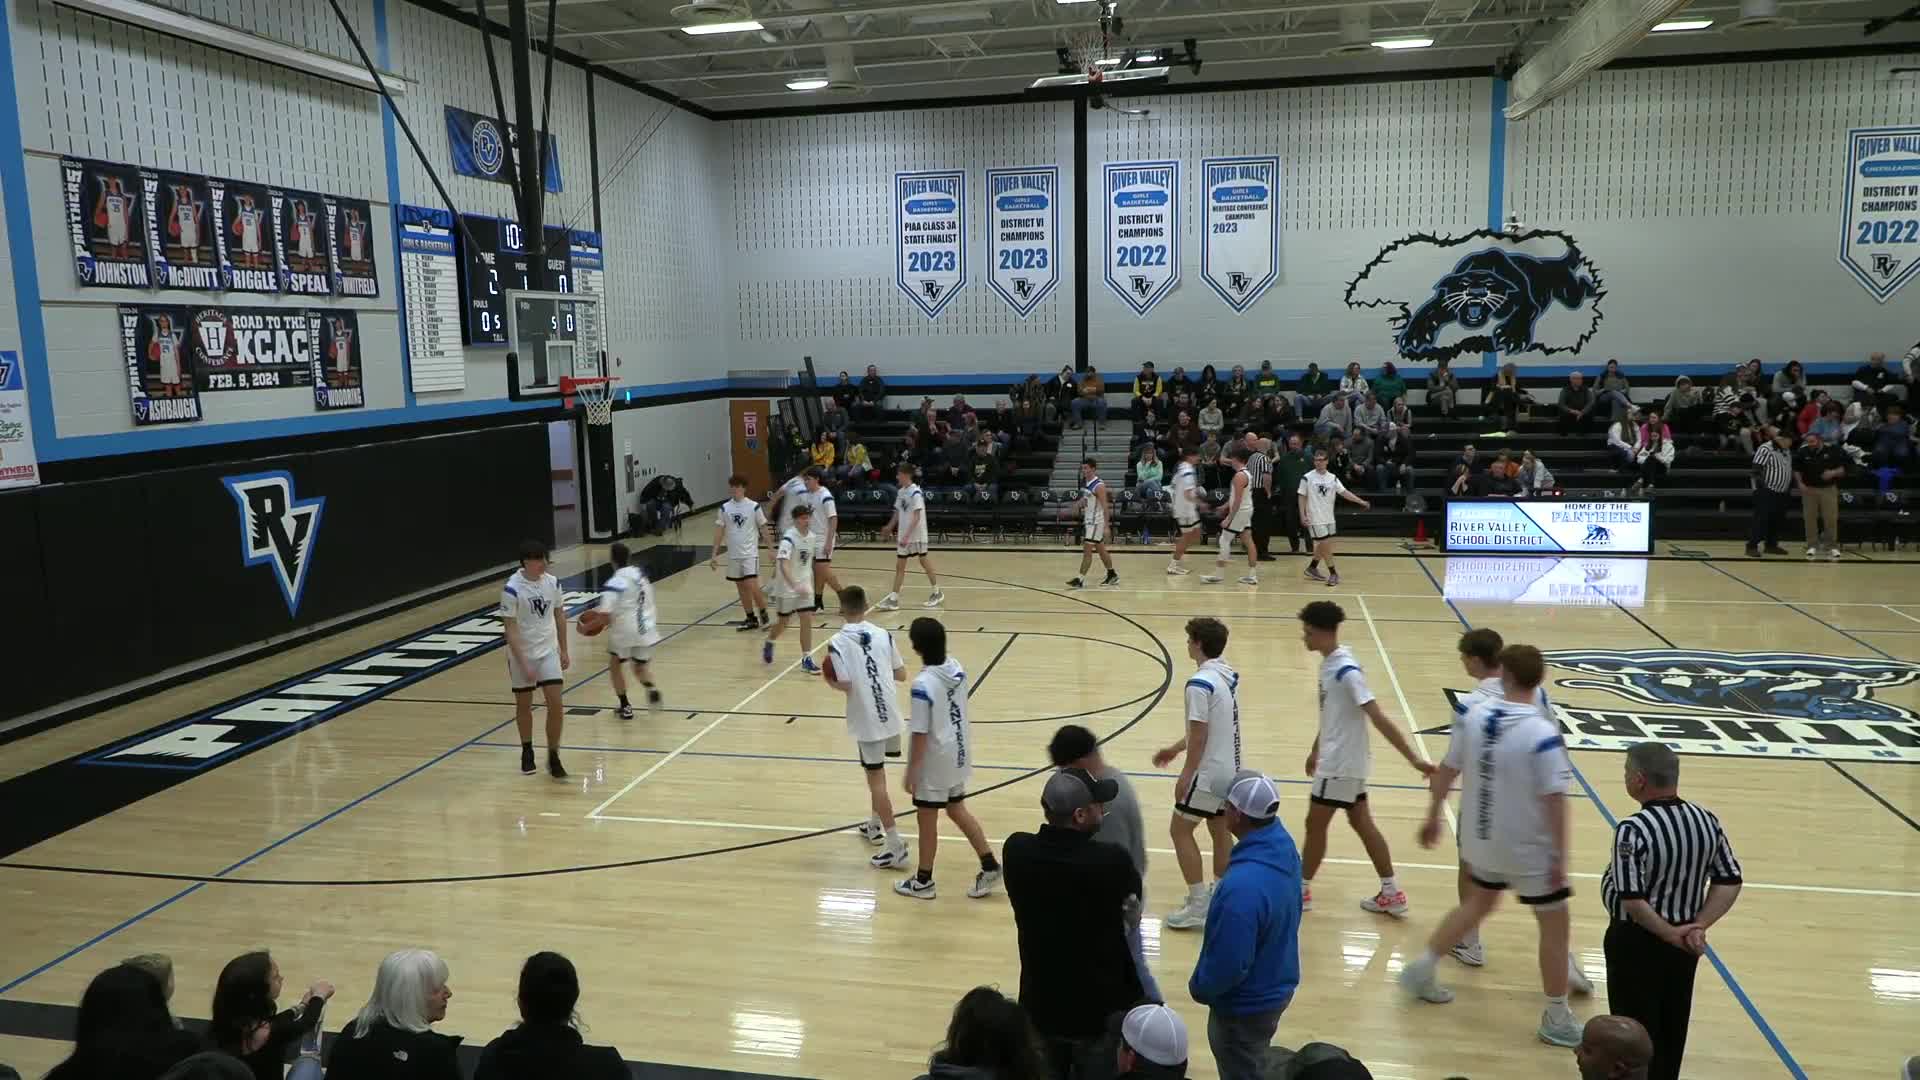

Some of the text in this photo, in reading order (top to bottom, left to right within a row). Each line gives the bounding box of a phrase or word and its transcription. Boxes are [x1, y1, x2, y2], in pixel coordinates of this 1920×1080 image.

[1858, 138, 1890, 160] RIVER
[994, 175, 1050, 196] RIVER VALLEY
[1112, 170, 1170, 192] RIVER VALLEY
[1210, 165, 1270, 187] RIVER VALLEY
[903, 179, 958, 200] RIVER VALLEY
[1863, 185, 1918, 197] DISTRICT VI
[66, 168, 92, 258] PANTHERS
[1212, 203, 1268, 212] HERITAGE CONFERENCE
[1225, 213, 1255, 221] CHAMPIONS
[1861, 200, 1918, 213] CHAMPIONS
[143, 179, 166, 262] PANTHERS
[211, 187, 232, 267] PANTHERS
[904, 221, 957, 232] PIAA CLASS 3A
[1001, 217, 1044, 229] DISTRICT VI
[1119, 214, 1163, 225] DISTRICT VI
[1213, 223, 1238, 233] 2023
[271, 196, 289, 271] PANTHERS
[325, 204, 343, 274] PANTHERS
[904, 234, 957, 245] STATE FINALIST
[1000, 231, 1045, 241] CHAMPIONS
[1118, 227, 1164, 239] CHAMPIONS
[1856, 219, 1919, 245] 2022
[547, 259, 566, 271] GUEST
[908, 250, 956, 273] 2023
[999, 248, 1048, 270] 2023
[1116, 245, 1167, 267] 2022
[95, 261, 148, 285] JOHNSTON
[168, 266, 219, 288] McDIVITT
[232, 269, 278, 291] RIGGLE
[290, 273, 331, 293] SPEAL
[489, 269, 498, 295] 2
[1226, 272, 1252, 295] RV
[920, 279, 944, 301] RV
[1010, 278, 1036, 300] RV
[1129, 275, 1154, 298] RV
[473, 300, 489, 308] FOULS
[231, 315, 306, 329] ROAD TO THE
[481, 311, 491, 332] 0
[566, 314, 574, 332] 0
[122, 315, 147, 398] PANTHERS
[233, 329, 309, 364] KCAC
[310, 318, 328, 388] PANTHERS
[208, 374, 236, 388] FEB.
[252, 371, 280, 386] 2024
[148, 398, 199, 421] ASHBAUGH
[1450, 522, 1528, 532] RIVER VALLEY
[1552, 512, 1641, 523] PANTHERS
[222, 470, 326, 618] RV
[1449, 535, 1543, 545] SCHOOL DISTRICT
[862, 644, 888, 723] PANTHERS
[947, 687, 965, 768] PANTHERS
